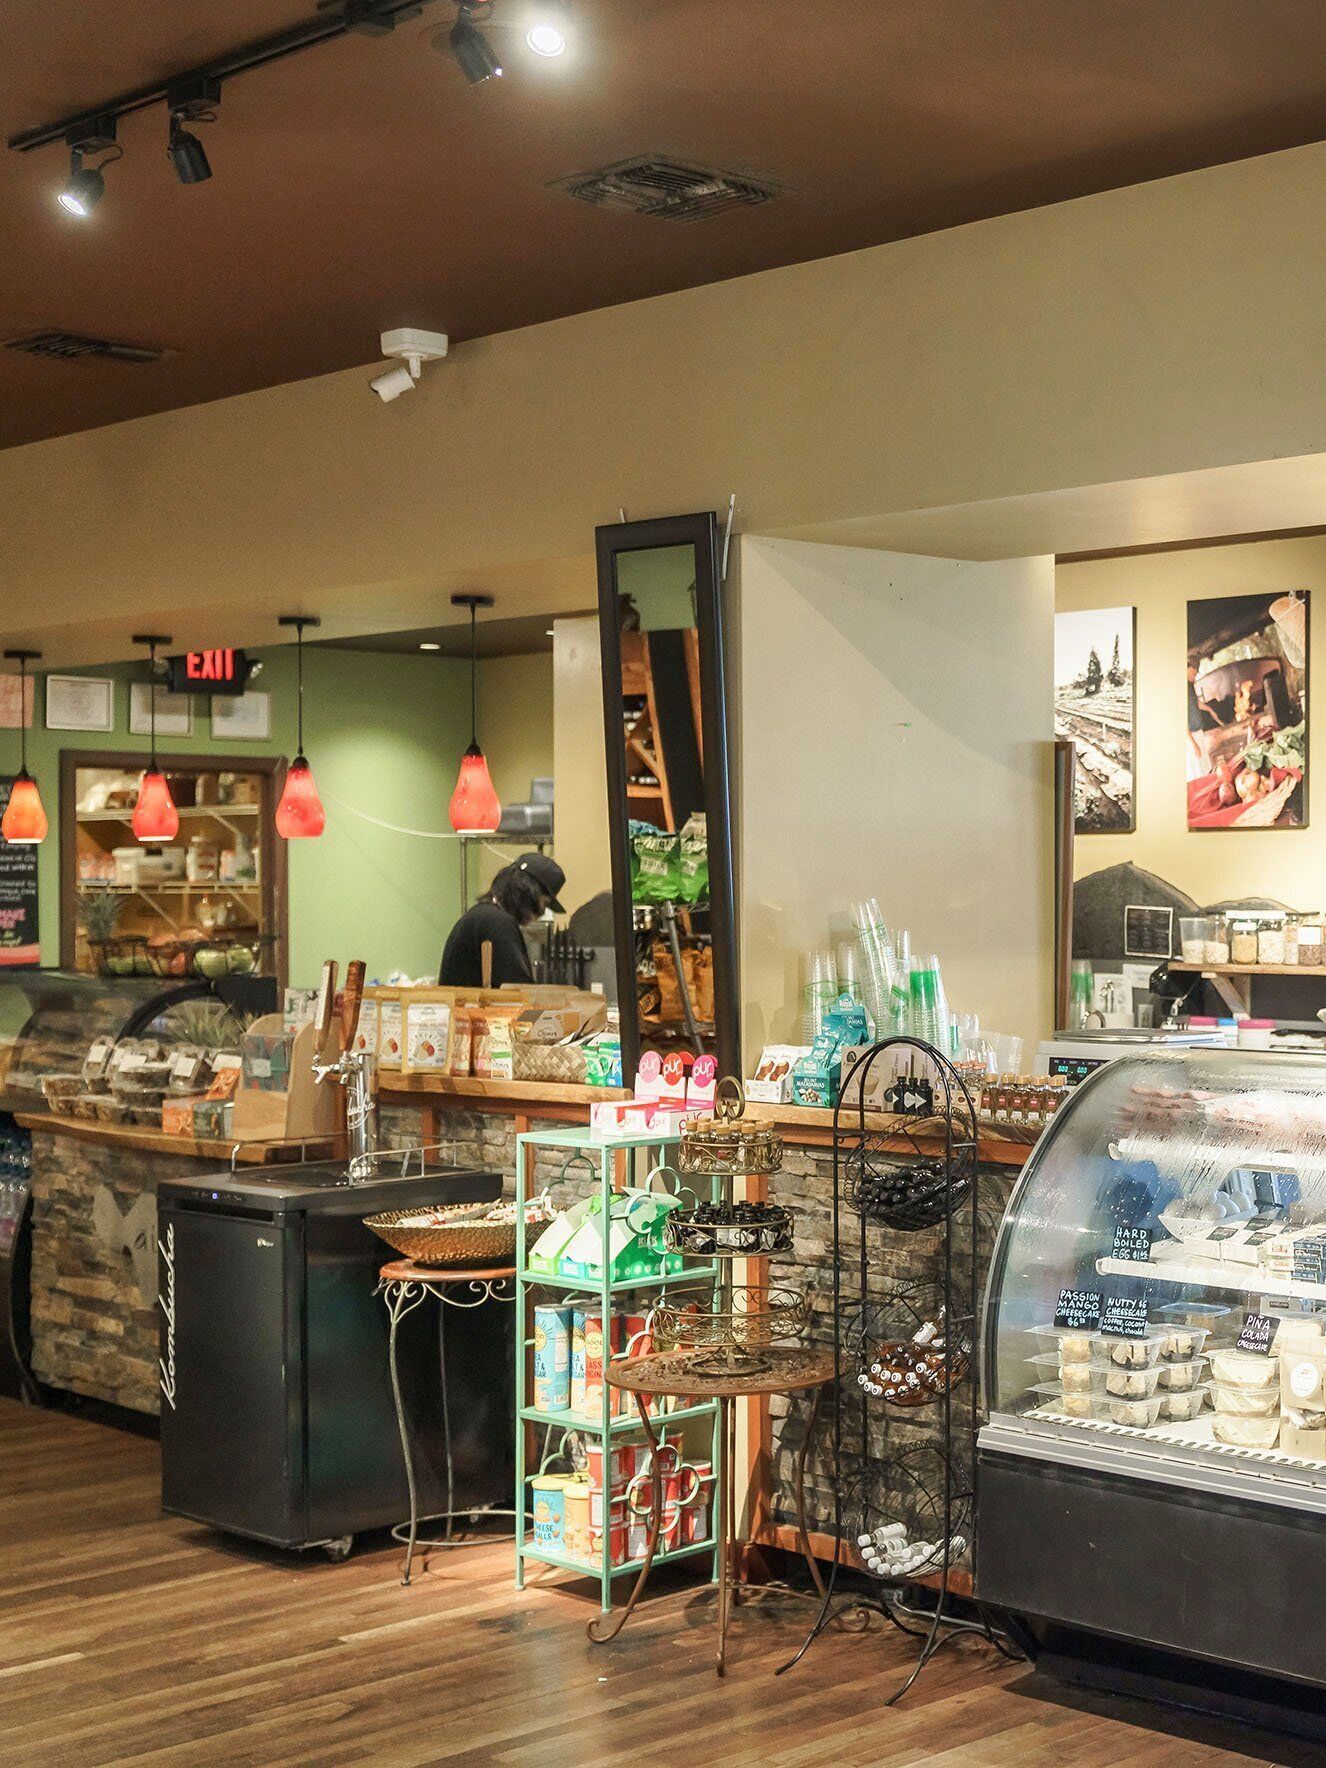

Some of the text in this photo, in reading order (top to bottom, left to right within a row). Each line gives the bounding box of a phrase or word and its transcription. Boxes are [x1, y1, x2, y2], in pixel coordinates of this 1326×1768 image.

[1116, 1226, 1147, 1239] HARD
[1113, 1238, 1150, 1248] BOILED
[1112, 1248, 1130, 1259] EGG
[1060, 1289, 1101, 1301] PASSION
[1057, 1300, 1100, 1310] MANGO
[1107, 1298, 1148, 1308] NUTTY $6
[158, 1222, 176, 1410] Kombucha
[1056, 1309, 1101, 1318] CHEESECAKE
[1106, 1307, 1148, 1317] CHEESECAKE
[1246, 1314, 1270, 1331] PIÑA
[1241, 1329, 1269, 1342] COLADA
